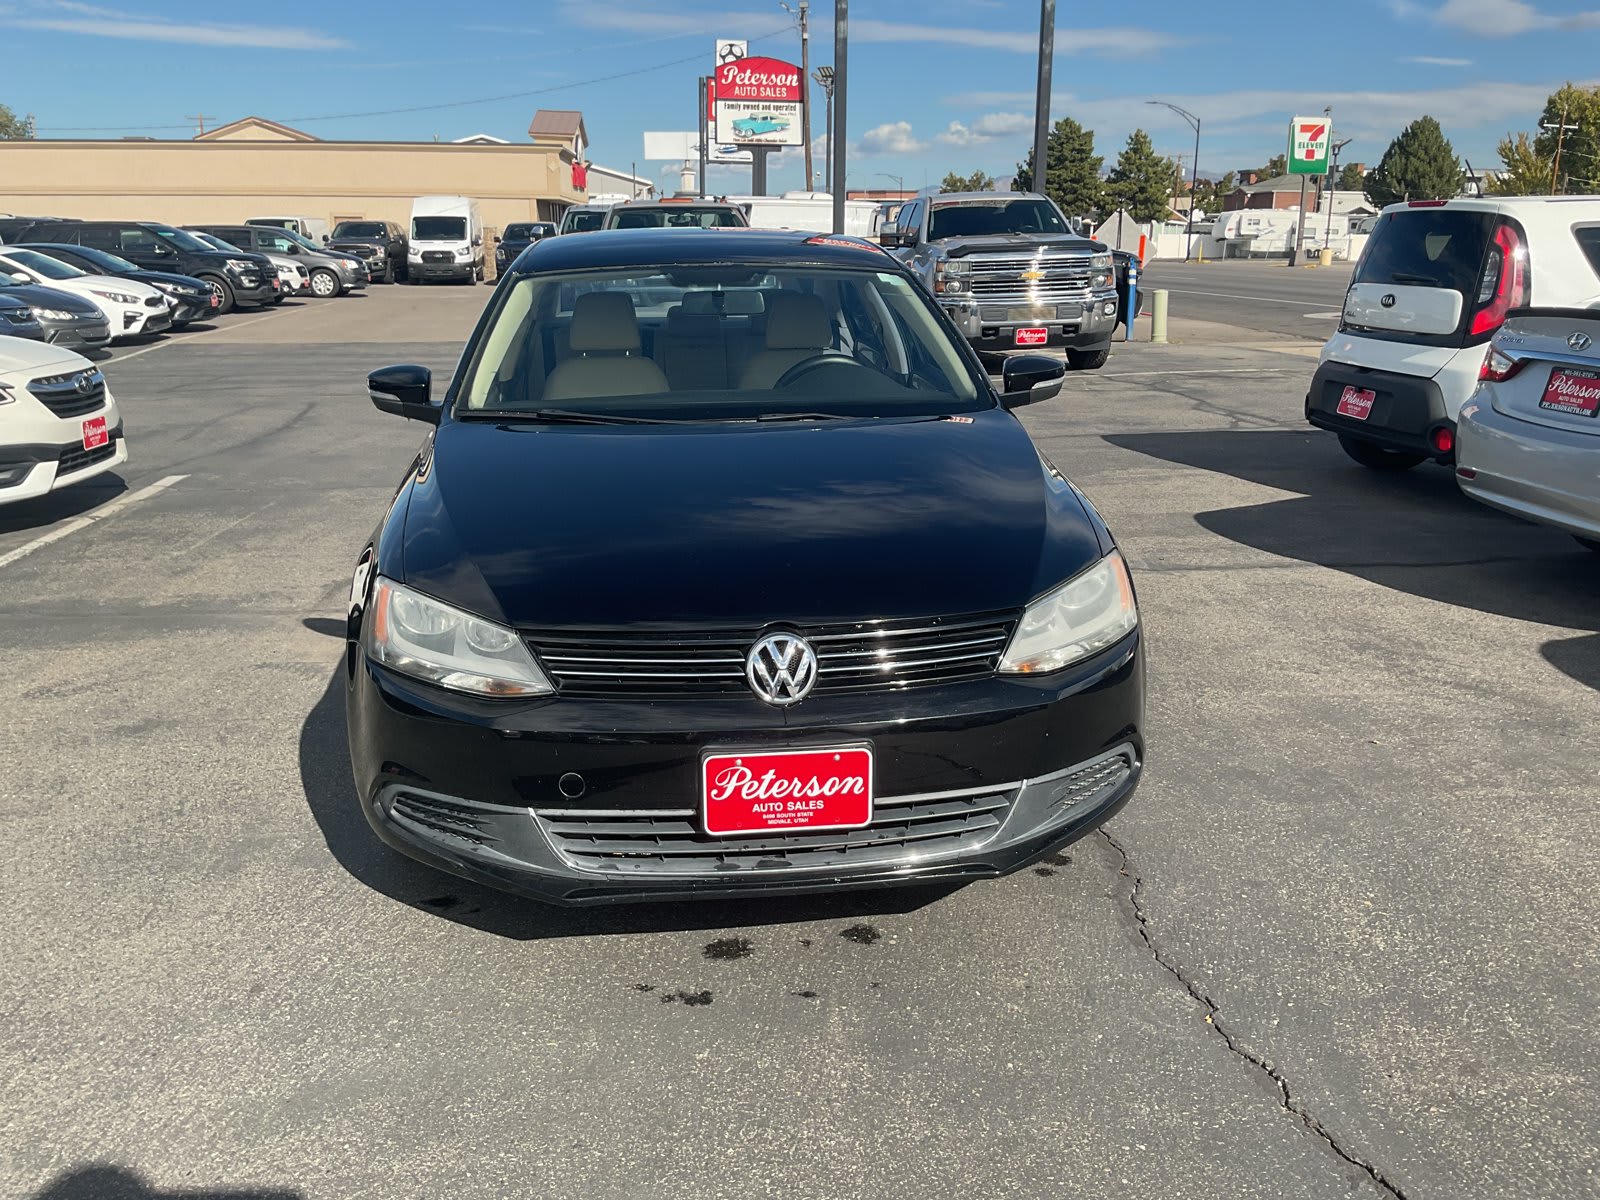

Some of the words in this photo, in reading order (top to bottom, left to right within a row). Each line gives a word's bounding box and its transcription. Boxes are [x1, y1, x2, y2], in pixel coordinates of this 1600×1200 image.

[721, 65, 799, 87] Peterson
[734, 86, 757, 97] AUTO
[760, 87, 787, 97] SALES
[724, 102, 741, 111] Family
[743, 103, 760, 111] owned
[773, 104, 797, 112] operated
[1300, 124, 1325, 160] 7
[1382, 296, 1393, 305] KIA
[1548, 375, 1600, 399] Peterson
[711, 766, 865, 801] Peterson
[752, 802, 783, 813] AUTO
[787, 800, 824, 811] SALES
